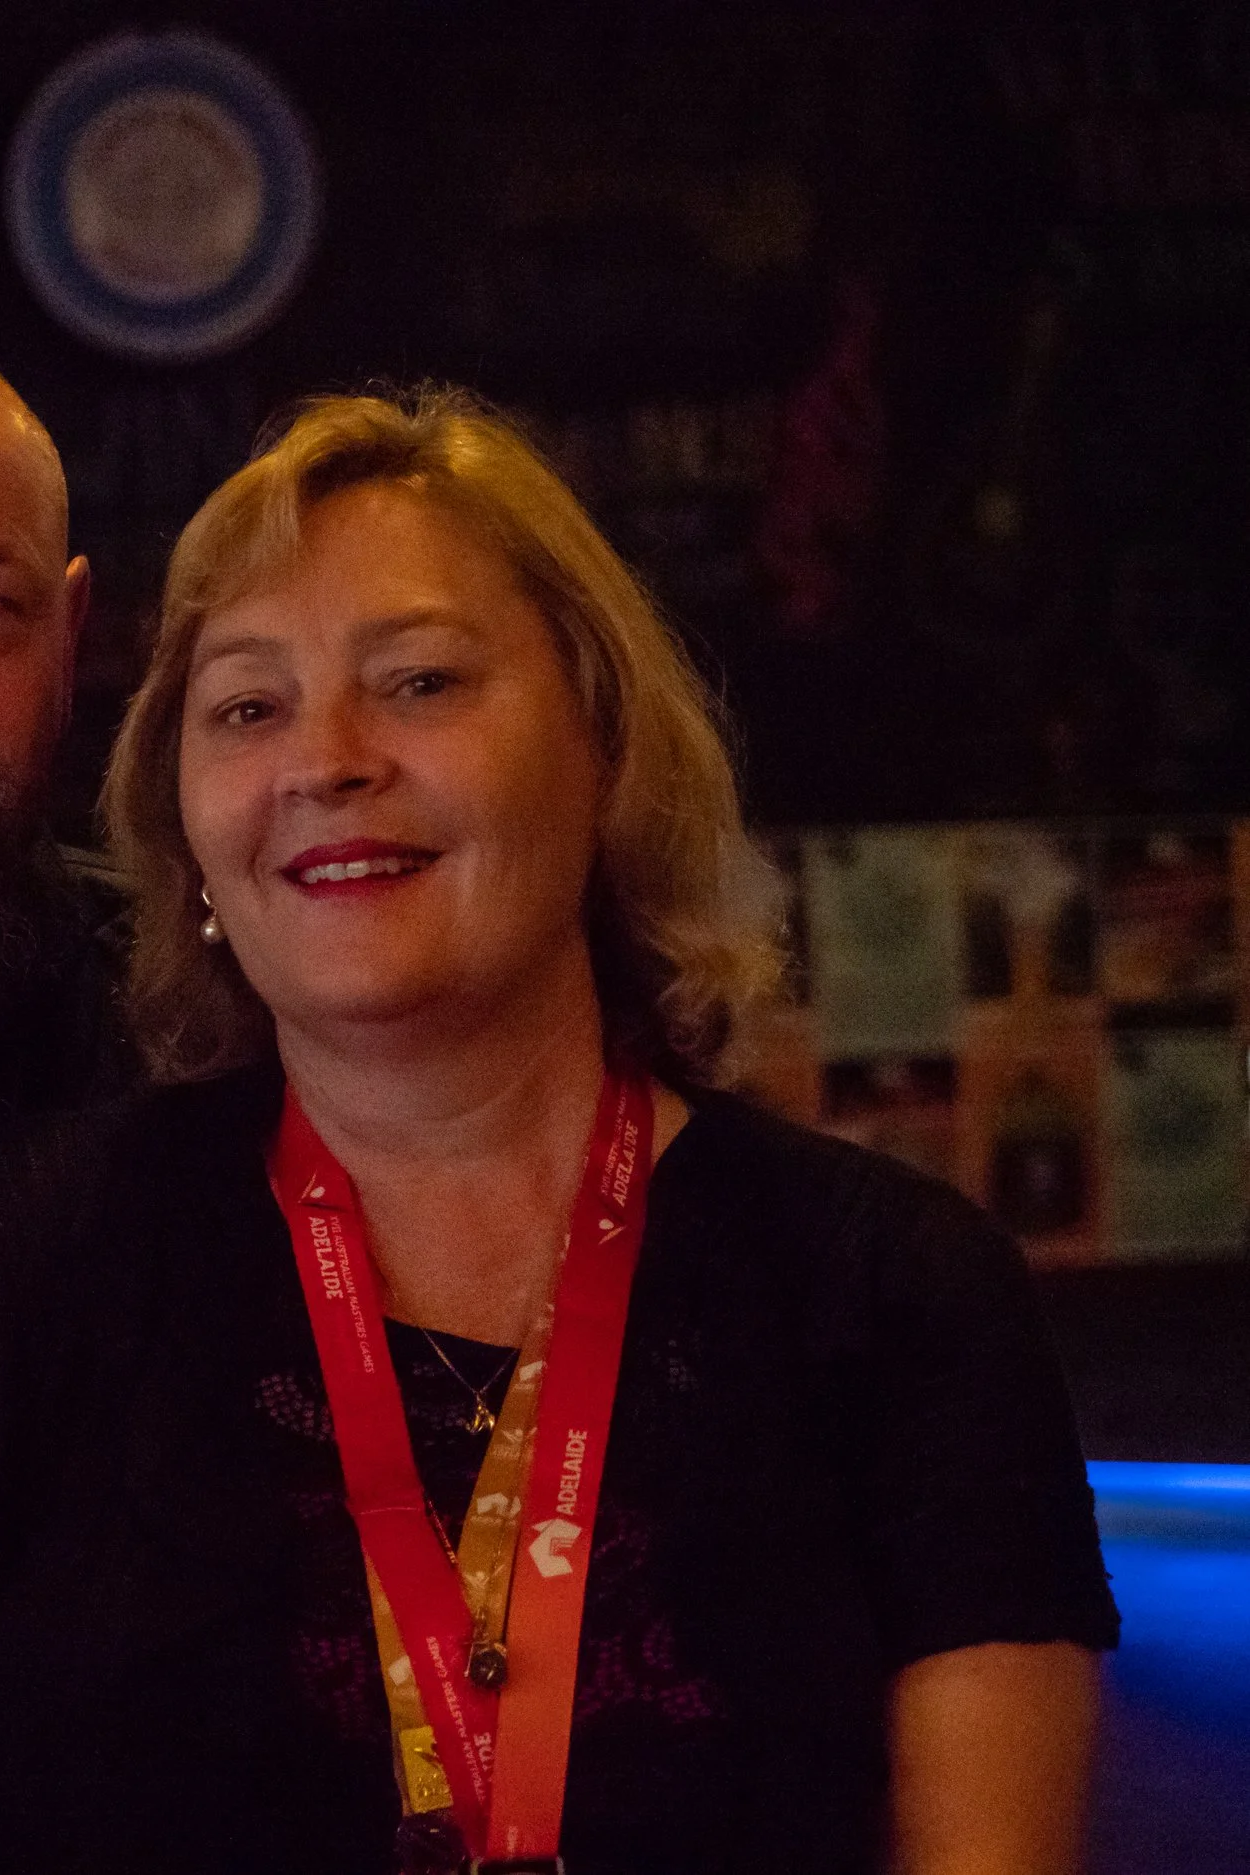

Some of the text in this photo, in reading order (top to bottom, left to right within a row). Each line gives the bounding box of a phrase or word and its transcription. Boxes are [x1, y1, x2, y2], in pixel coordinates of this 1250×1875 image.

[612, 1119, 639, 1209] ADELAIDE
[308, 1215, 344, 1300] ADELAIDE
[333, 1234, 357, 1293] AUSTRALIAN
[350, 1295, 367, 1338] MASTERS
[359, 1341, 375, 1374] GAMES
[555, 1427, 588, 1516] ADELAIDE
[441, 1680, 468, 1739] MASTERS
